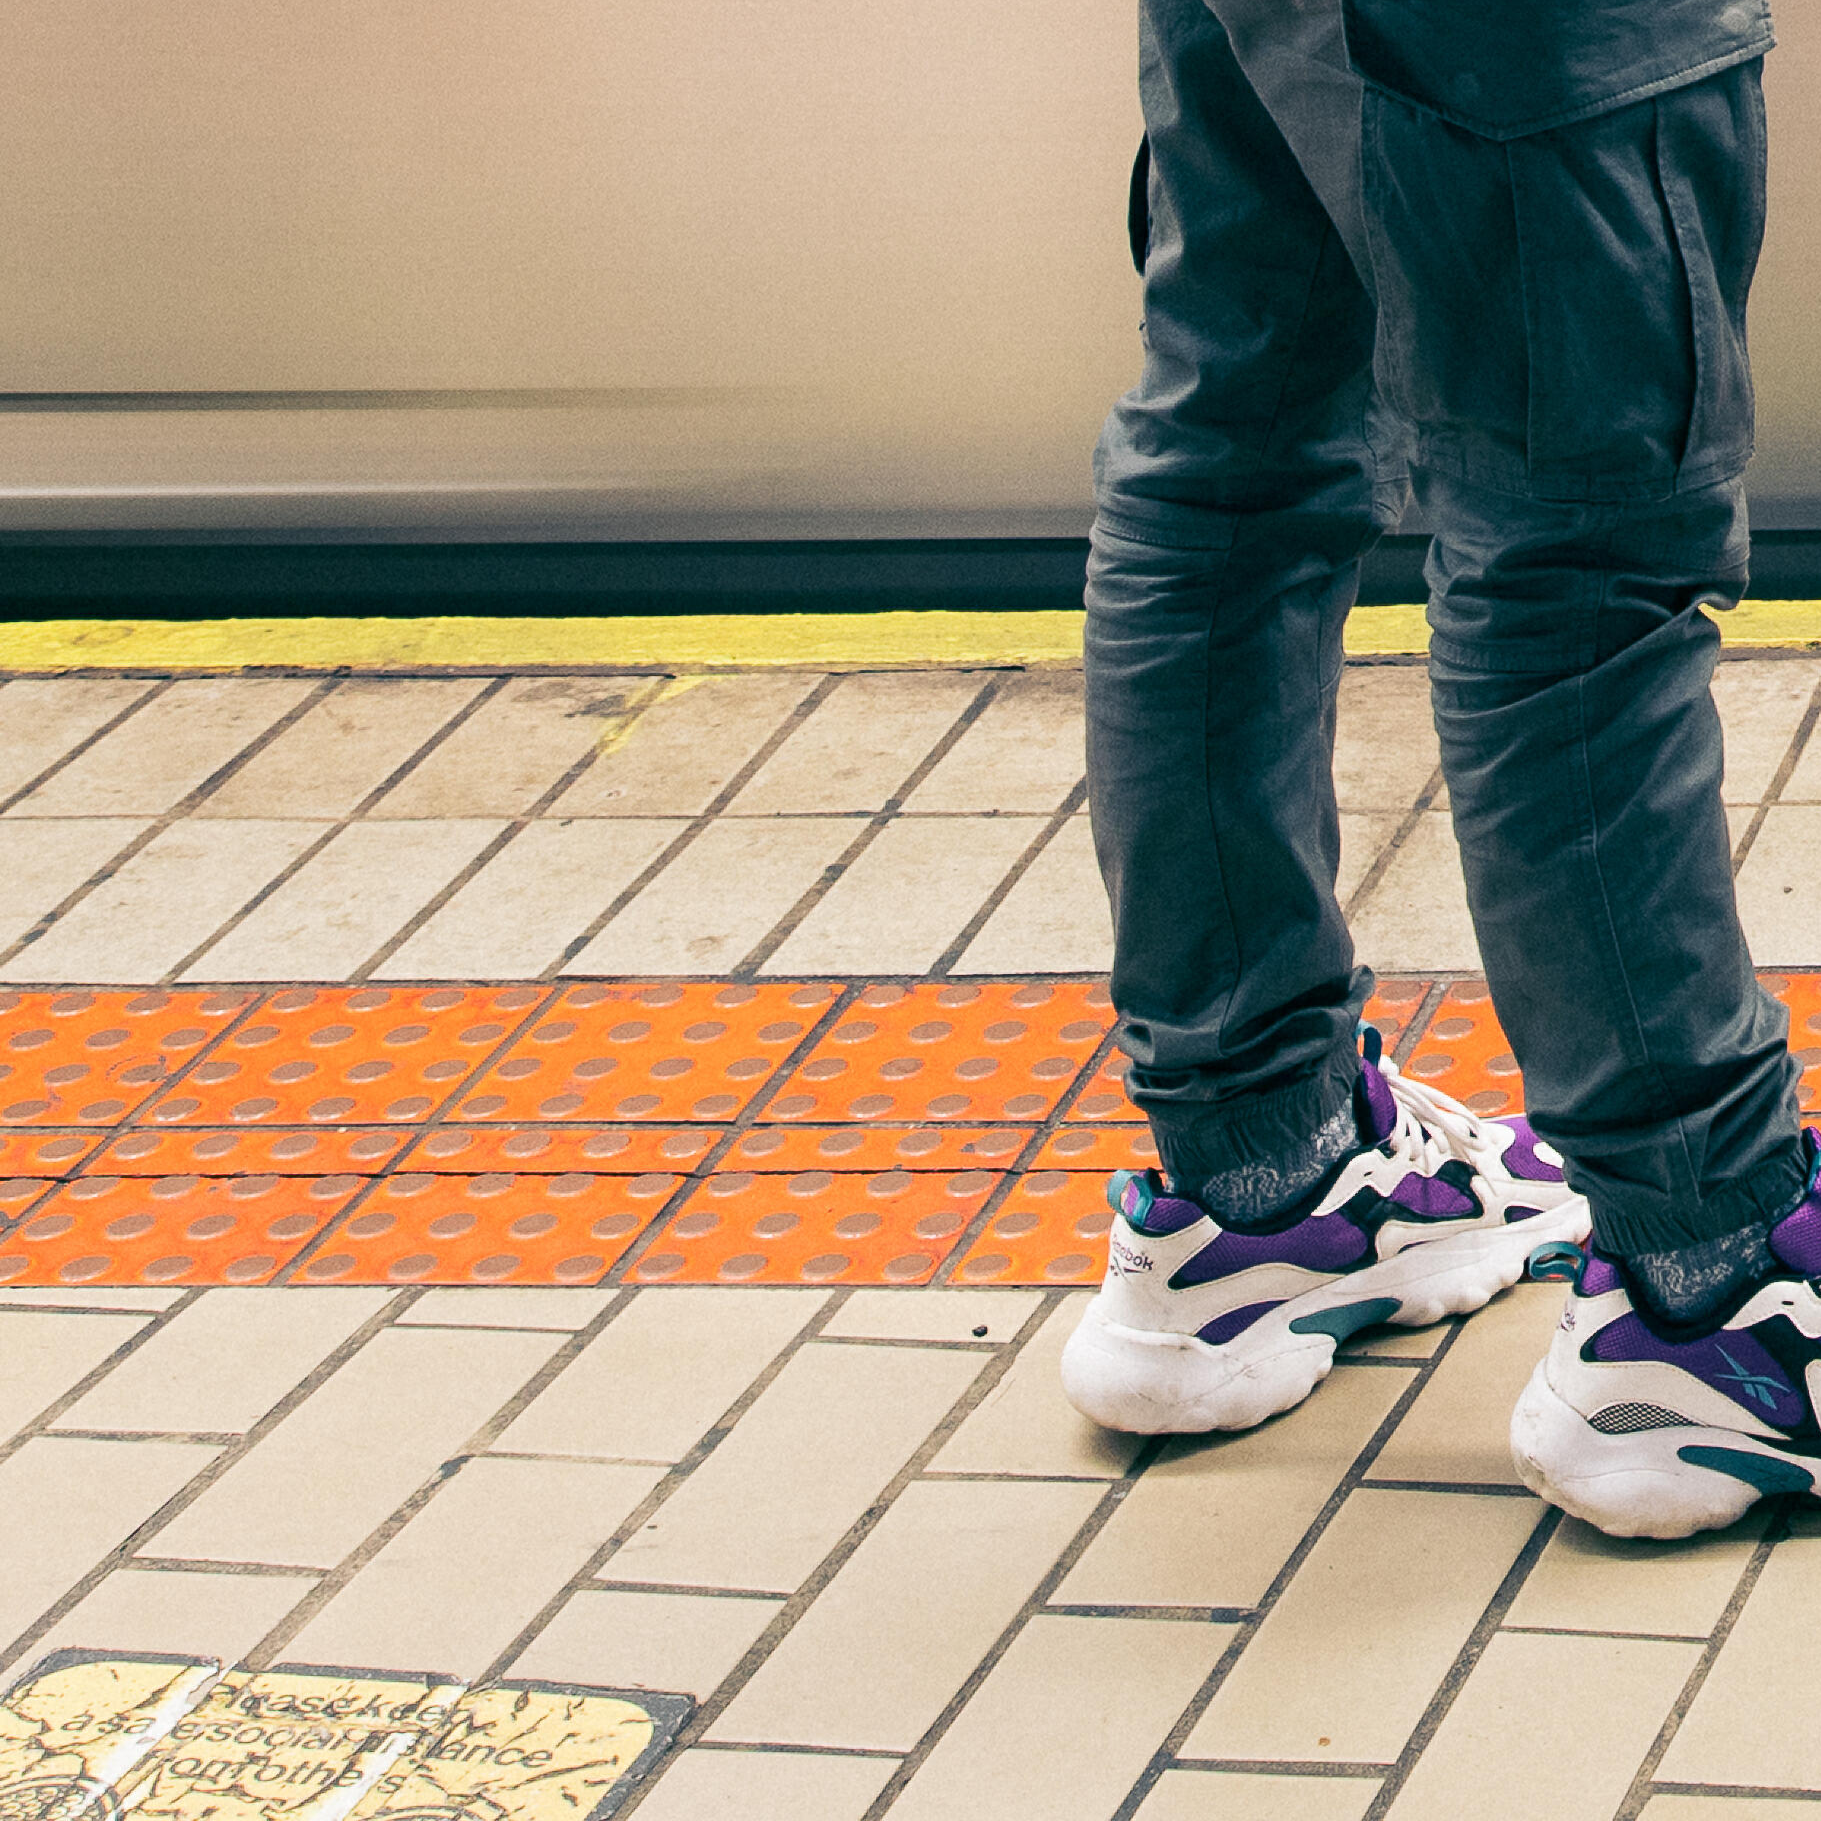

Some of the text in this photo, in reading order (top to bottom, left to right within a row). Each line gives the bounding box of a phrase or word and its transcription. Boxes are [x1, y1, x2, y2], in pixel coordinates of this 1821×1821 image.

[97, 1713, 202, 1742] sae
[347, 1731, 553, 1768] istance
[133, 1748, 407, 1794] fom othes
